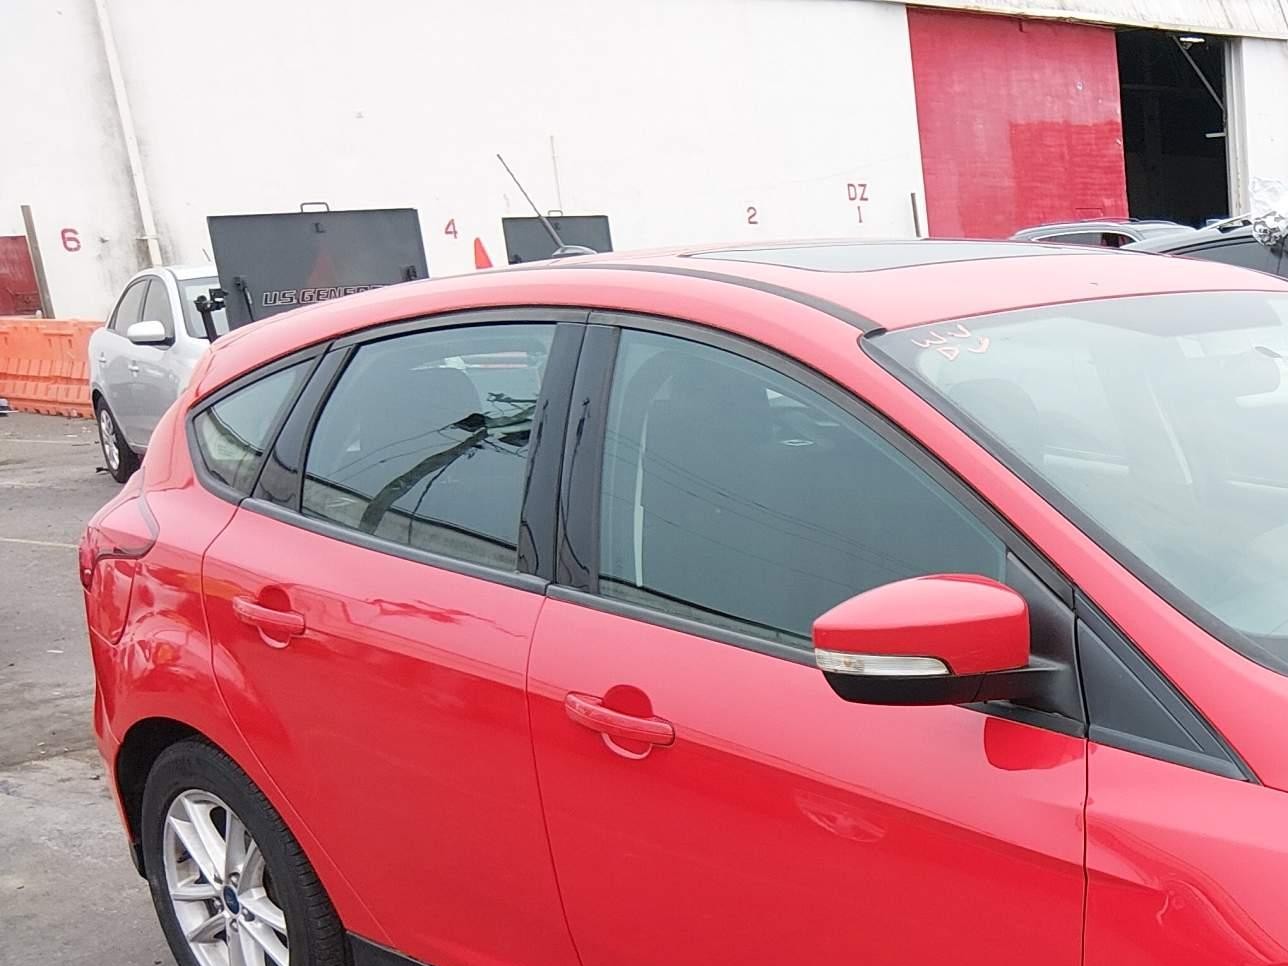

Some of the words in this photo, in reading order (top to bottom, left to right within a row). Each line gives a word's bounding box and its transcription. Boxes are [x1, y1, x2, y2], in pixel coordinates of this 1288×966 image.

[746, 206, 759, 225] 2
[444, 219, 458, 239] 4
[61, 228, 82, 252] 6
